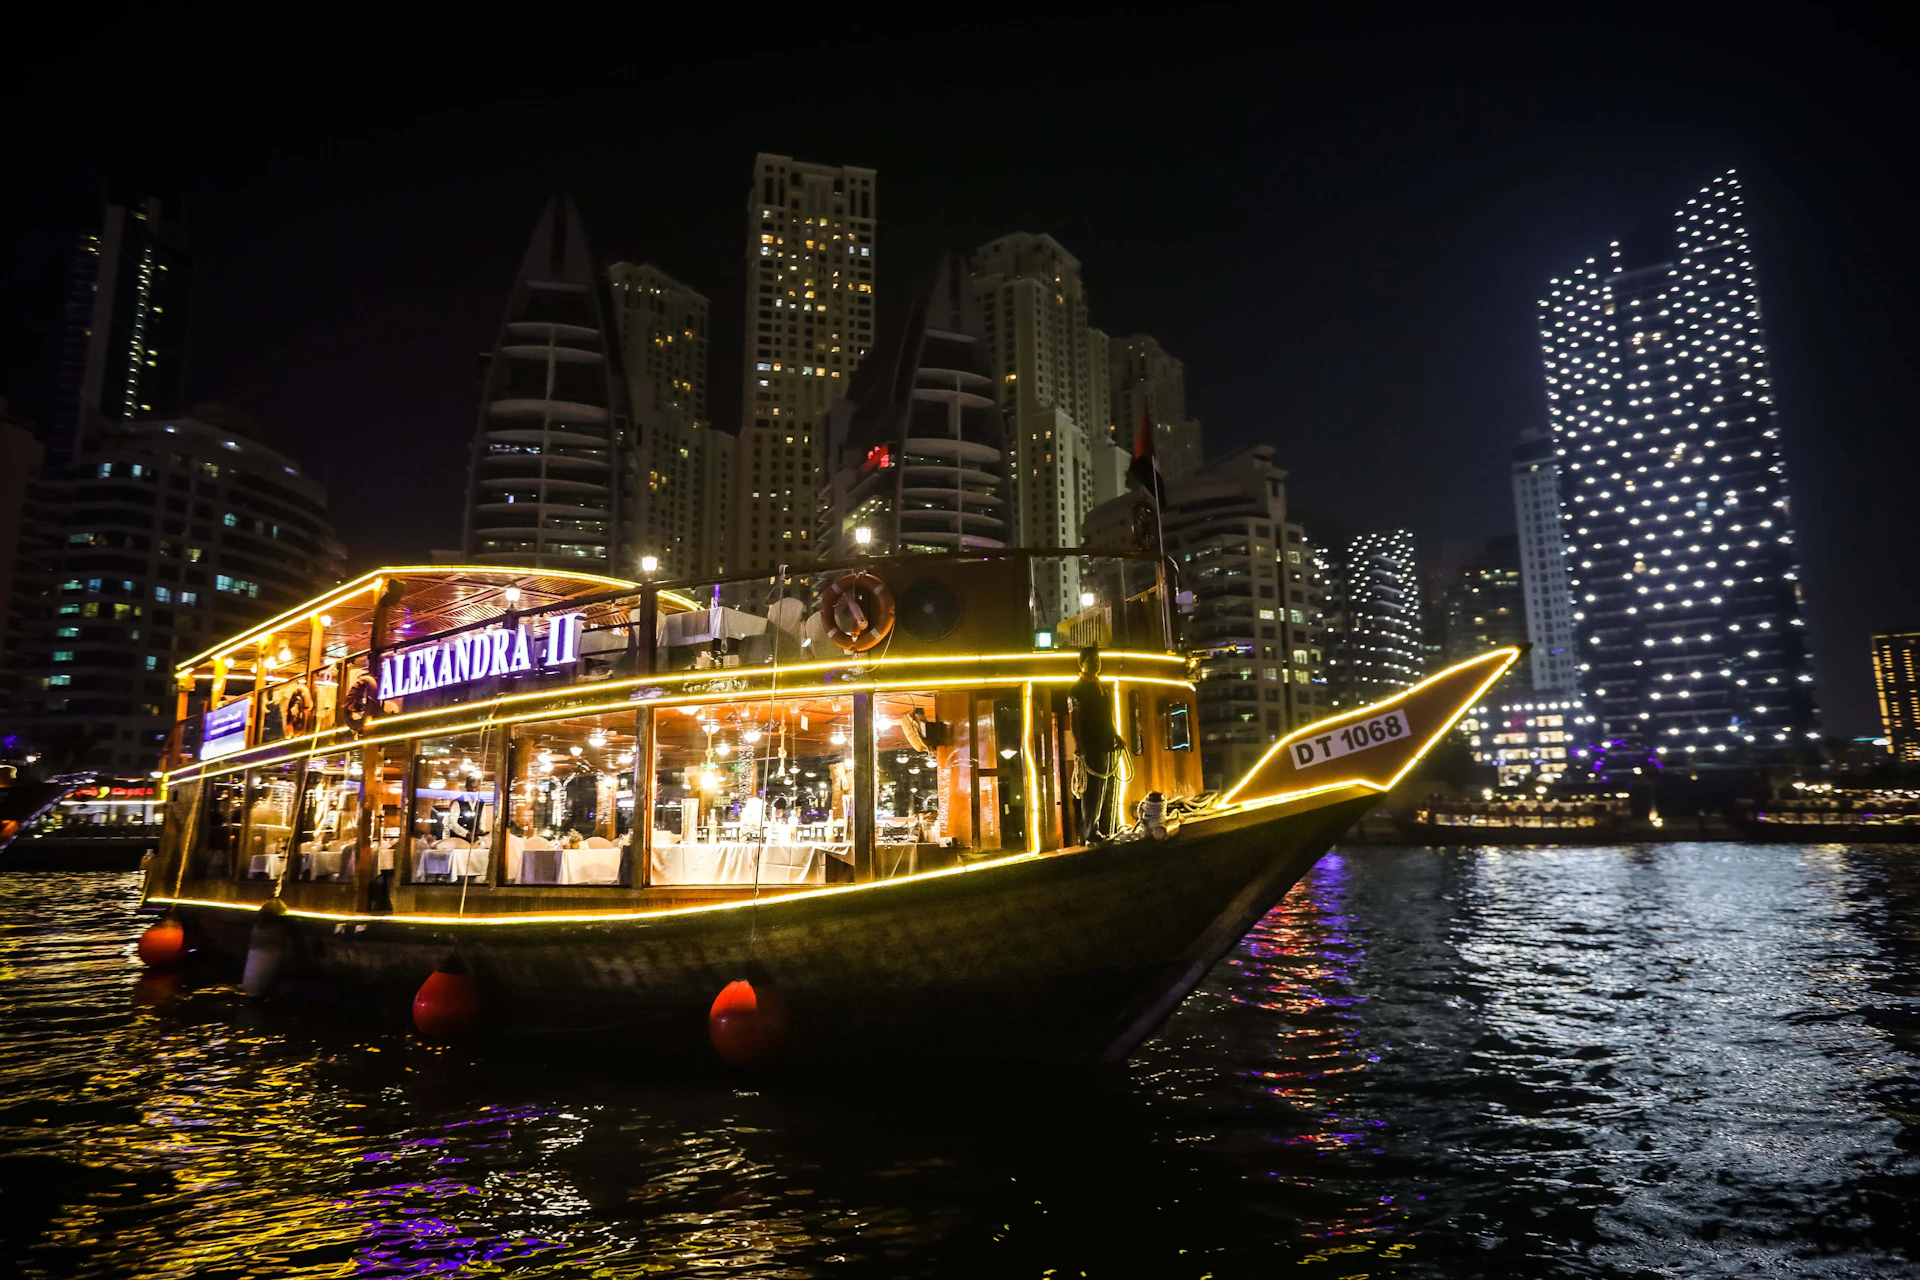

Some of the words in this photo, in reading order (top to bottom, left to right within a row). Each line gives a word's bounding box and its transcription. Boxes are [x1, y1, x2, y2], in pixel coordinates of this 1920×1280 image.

[378, 624, 531, 700] ALEXANDRA
[544, 612, 579, 667] II
[1341, 715, 1403, 750] 1068
